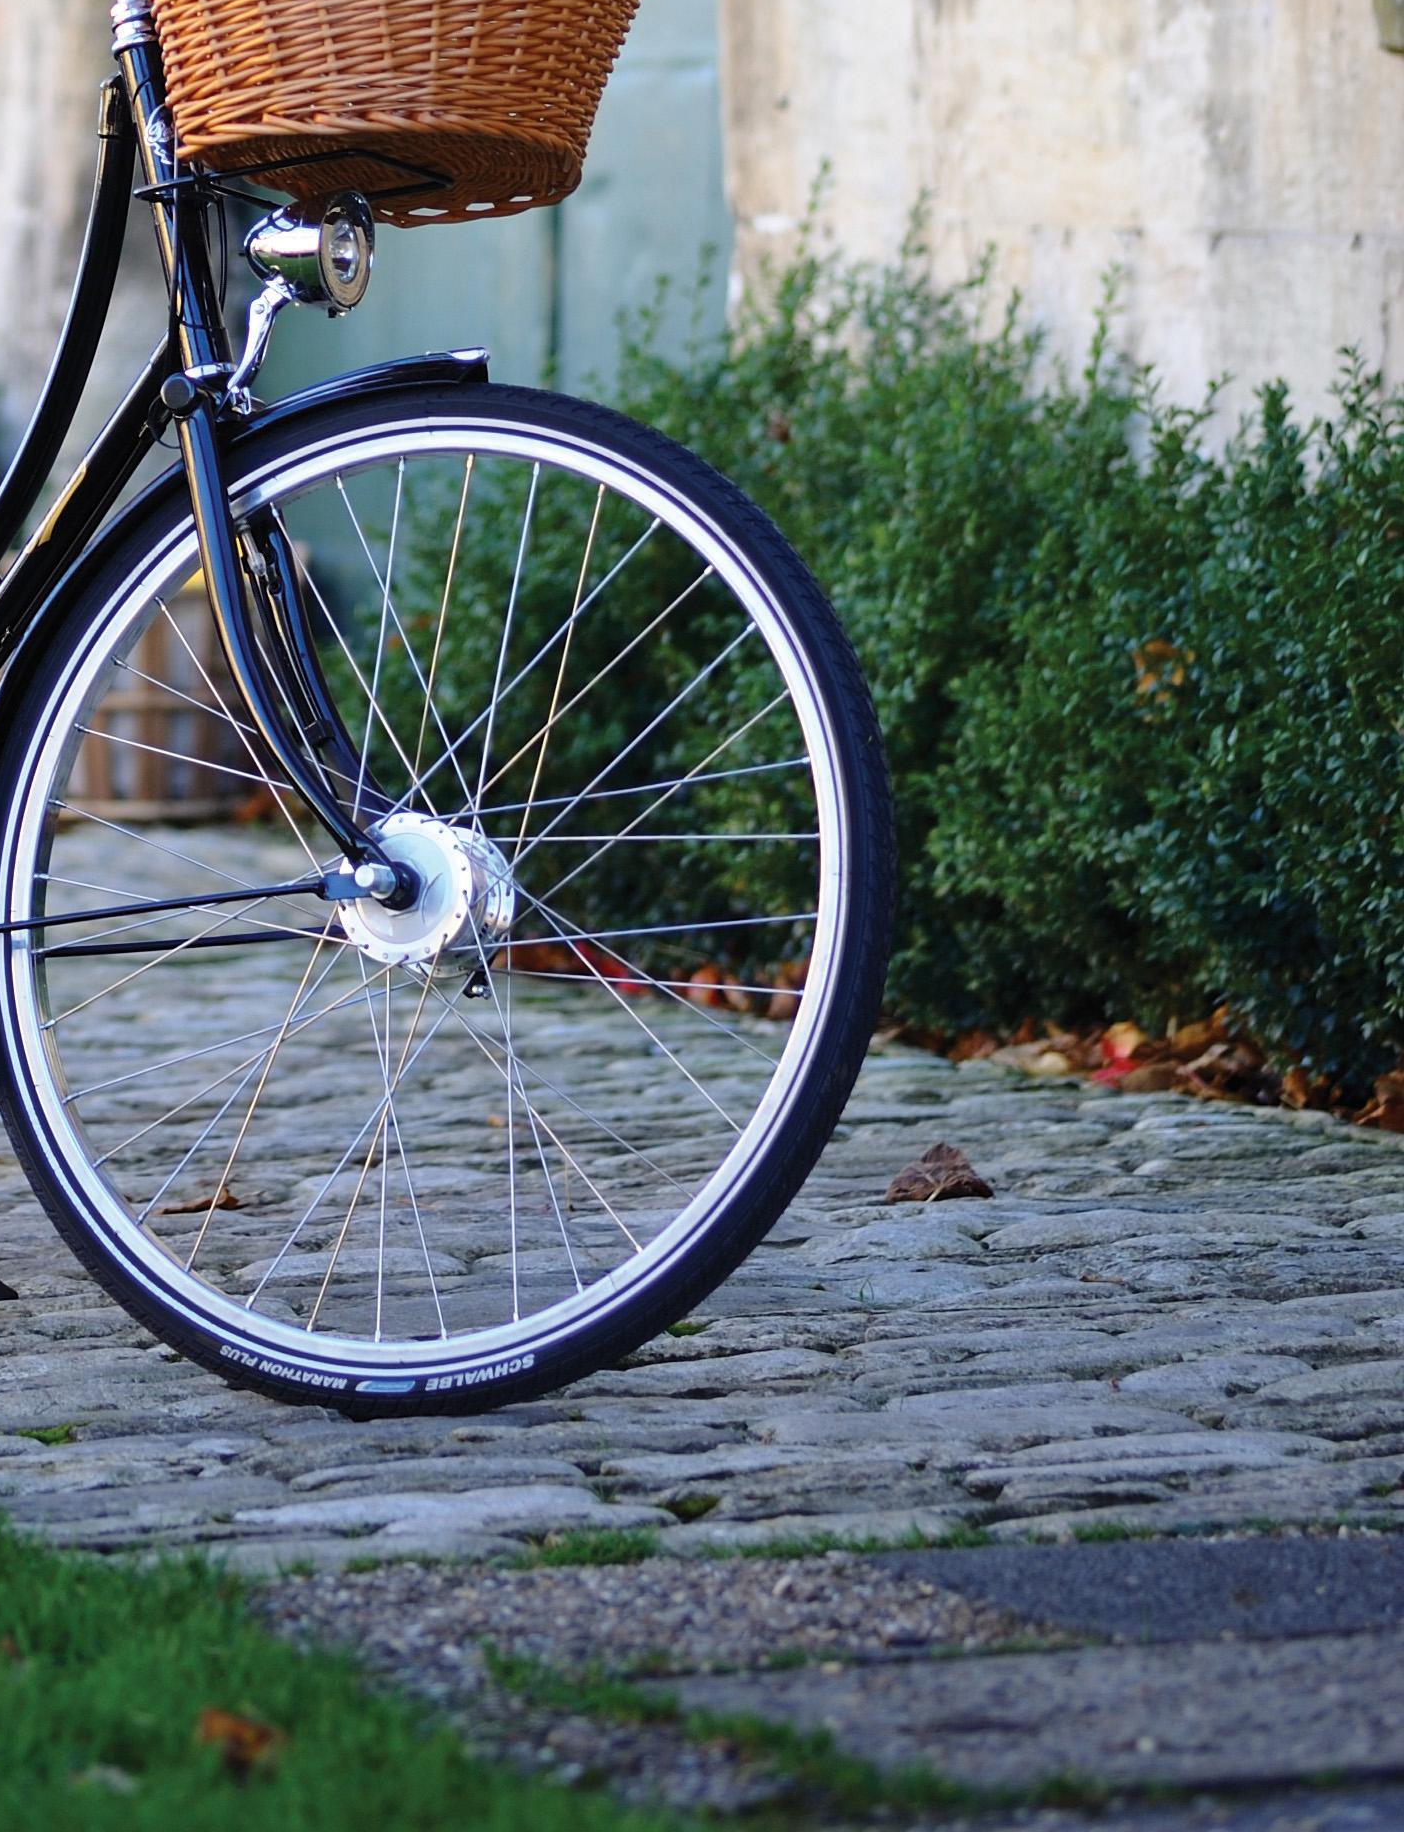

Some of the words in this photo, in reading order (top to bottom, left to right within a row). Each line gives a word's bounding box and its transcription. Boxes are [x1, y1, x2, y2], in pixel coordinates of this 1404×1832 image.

[220, 1344, 256, 1370] PLUS
[257, 1360, 347, 1389] MARATHON
[424, 1353, 536, 1392] SCHWALBE
